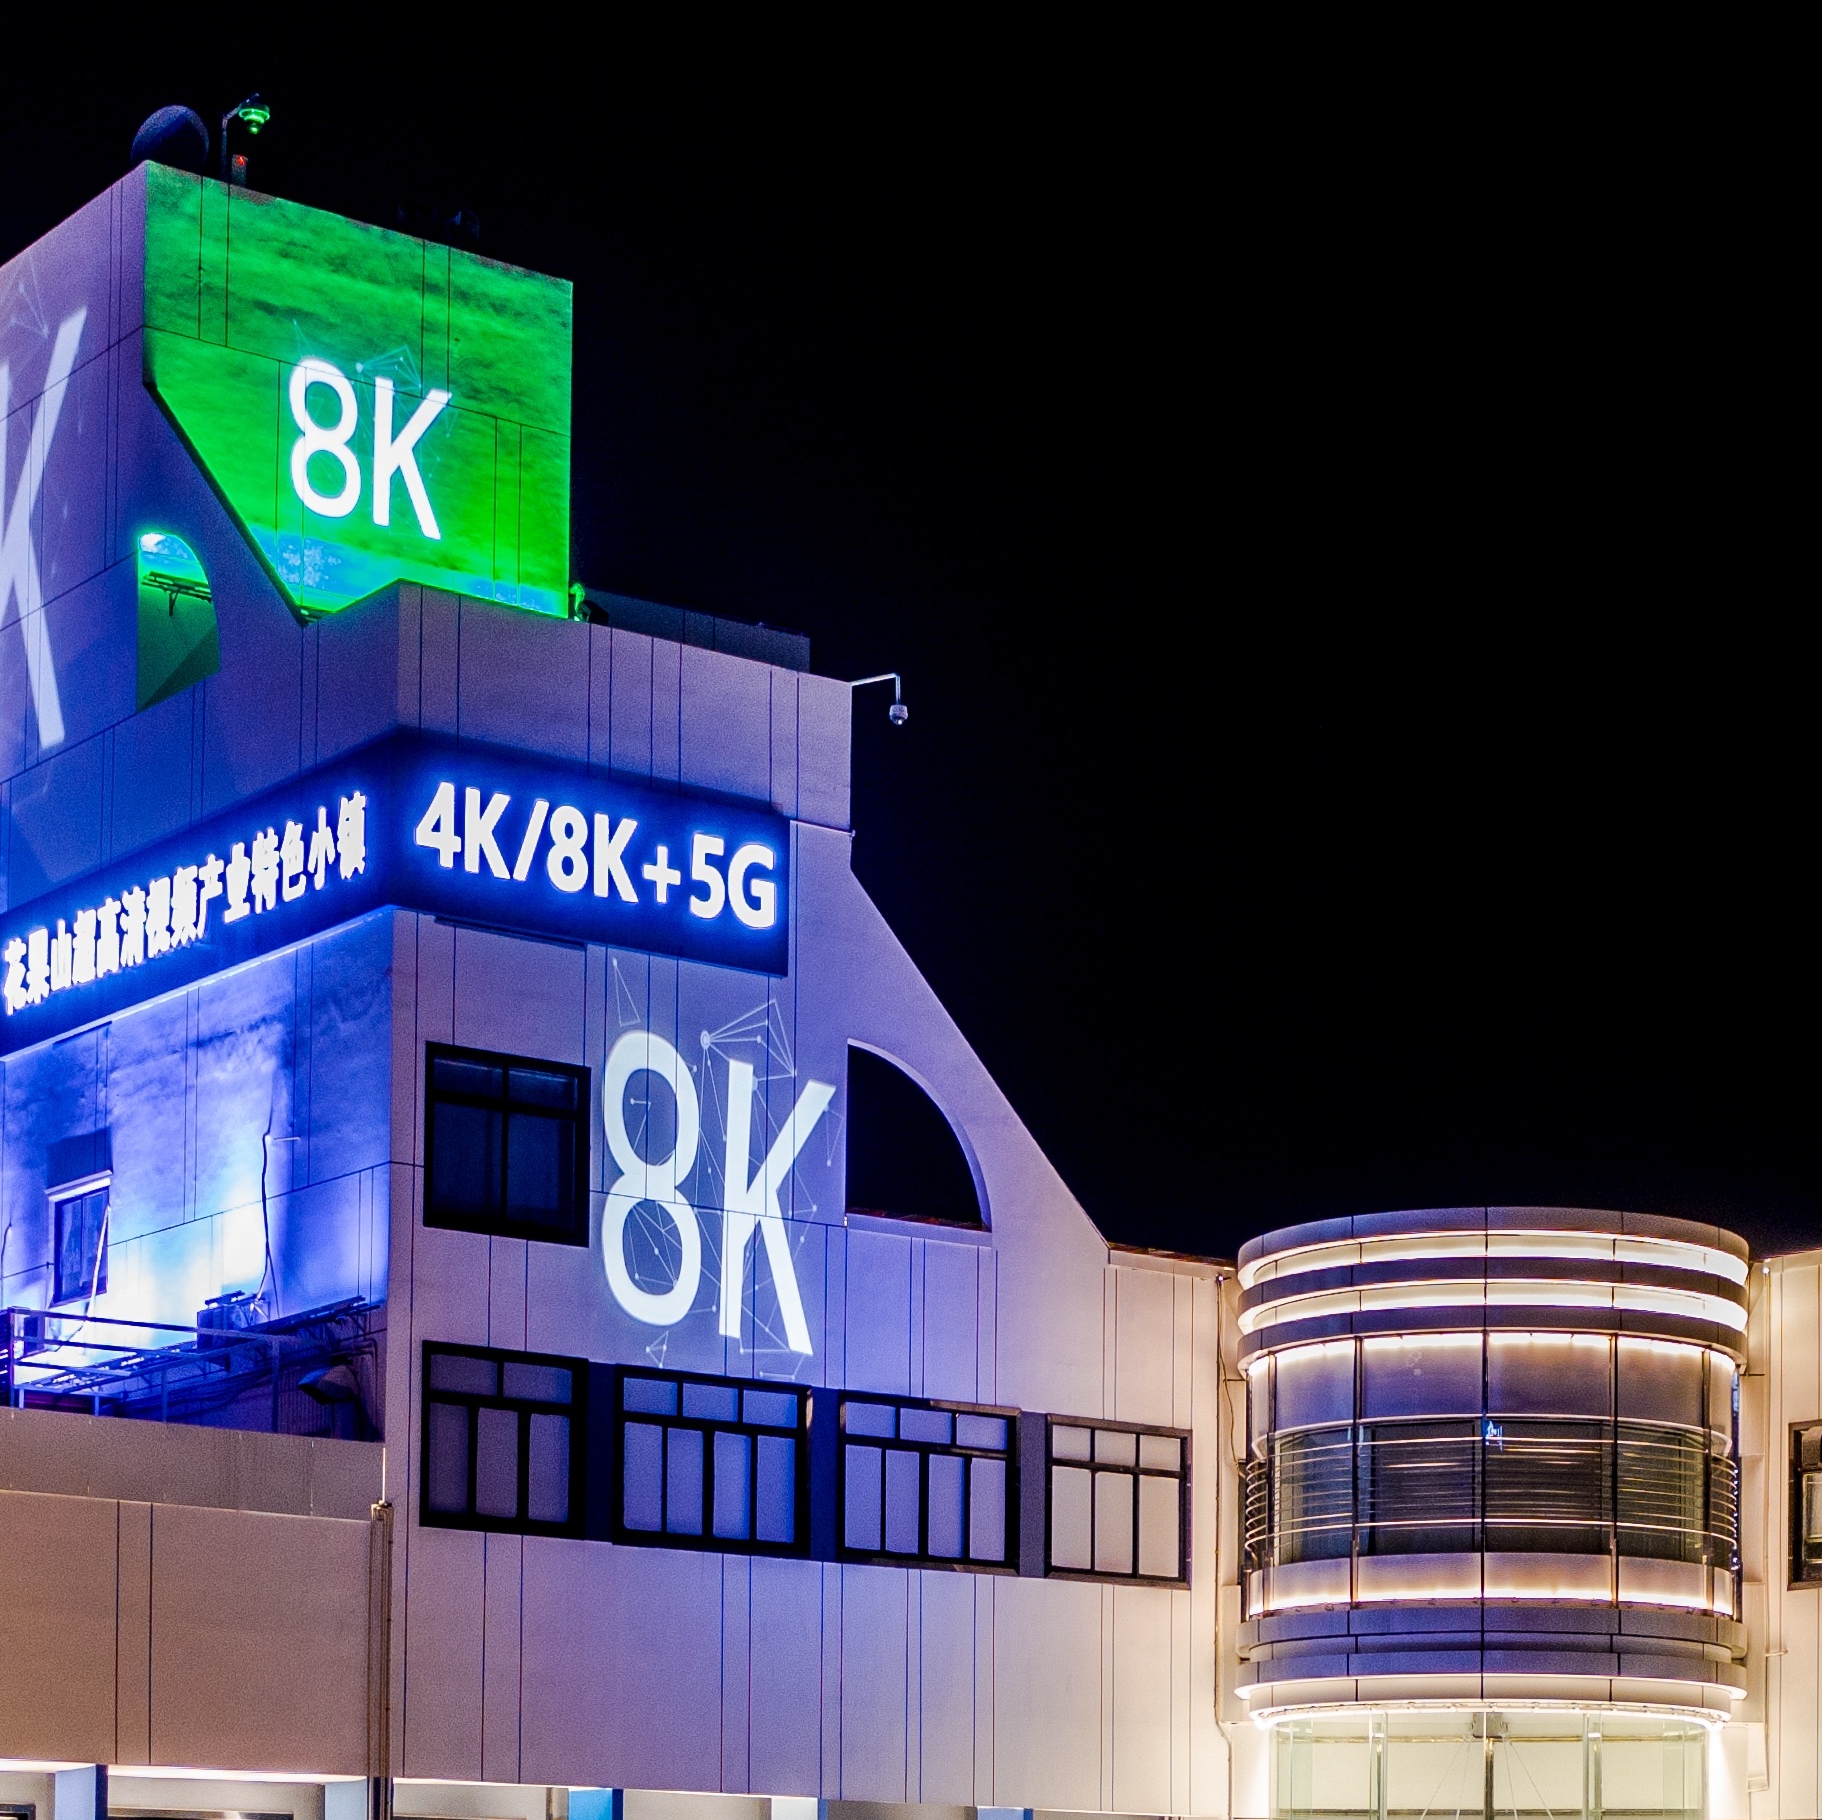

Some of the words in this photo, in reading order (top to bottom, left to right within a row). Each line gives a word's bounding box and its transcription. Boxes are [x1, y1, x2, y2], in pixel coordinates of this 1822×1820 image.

[288, 357, 451, 541] 8K
[3, 791, 367, 1016] 花果山超高清视频产业特色小镇
[414, 780, 777, 930] 4K/8K+5G
[601, 1029, 837, 1357] 8K
